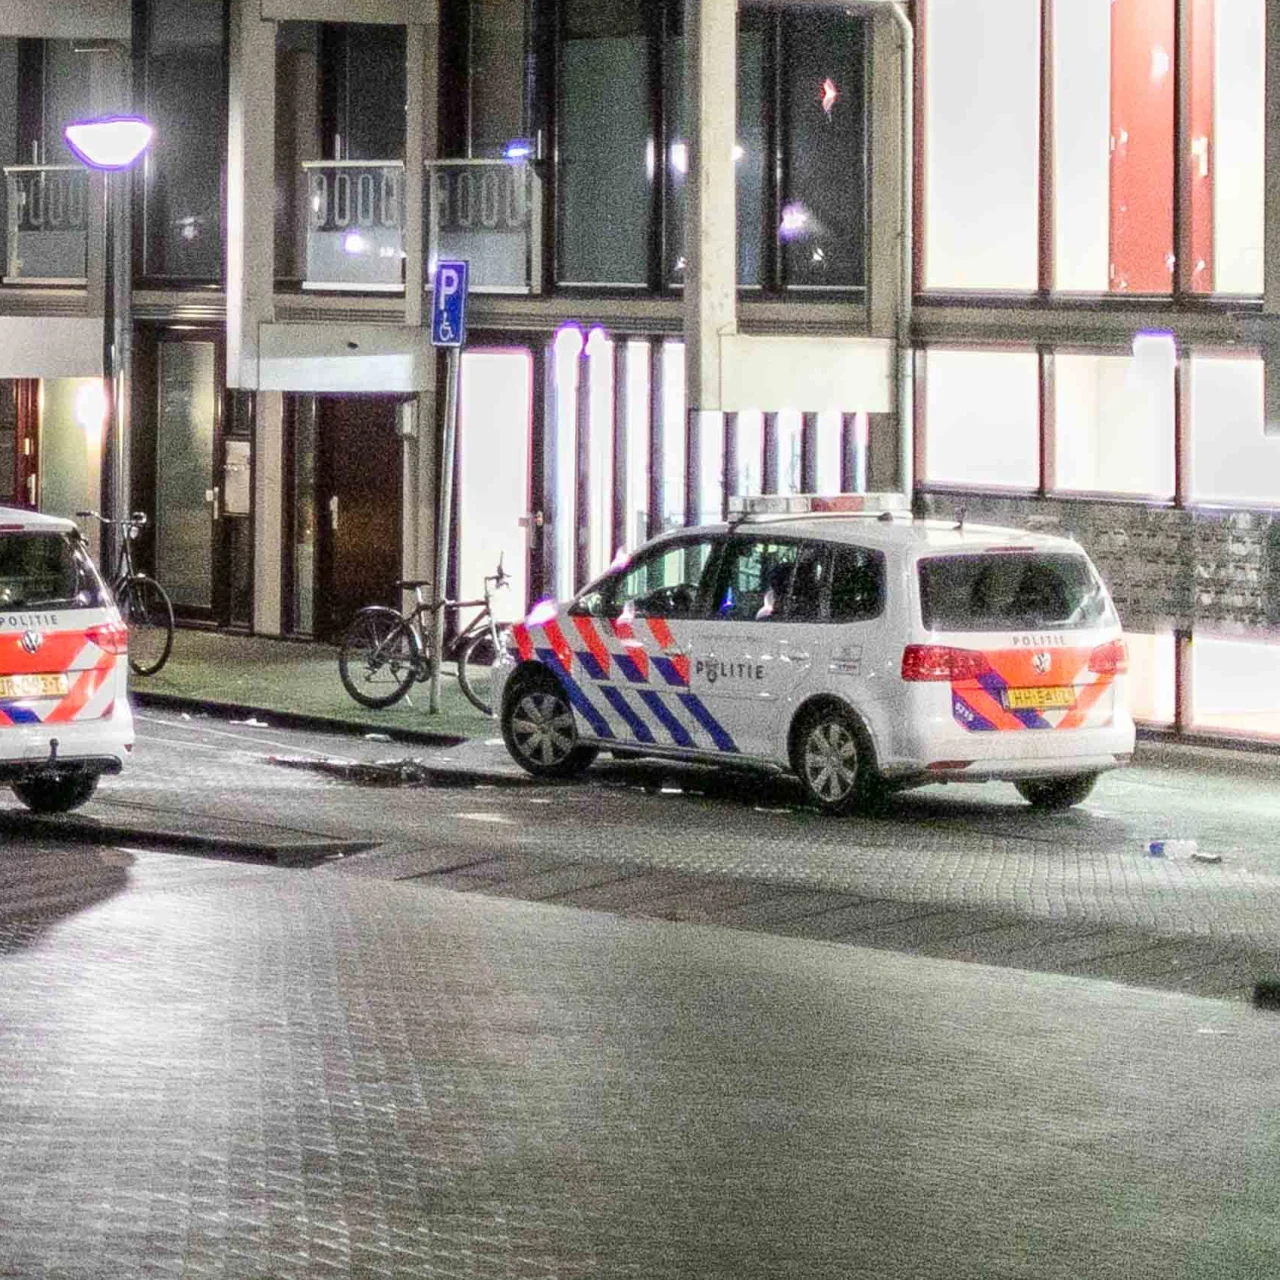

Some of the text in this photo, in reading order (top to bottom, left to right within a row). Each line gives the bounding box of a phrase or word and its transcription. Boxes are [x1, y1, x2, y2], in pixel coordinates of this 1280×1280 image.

[440, 269, 459, 310] P
[1012, 635, 1066, 646] POLITIE
[695, 660, 765, 682] POLITIE
